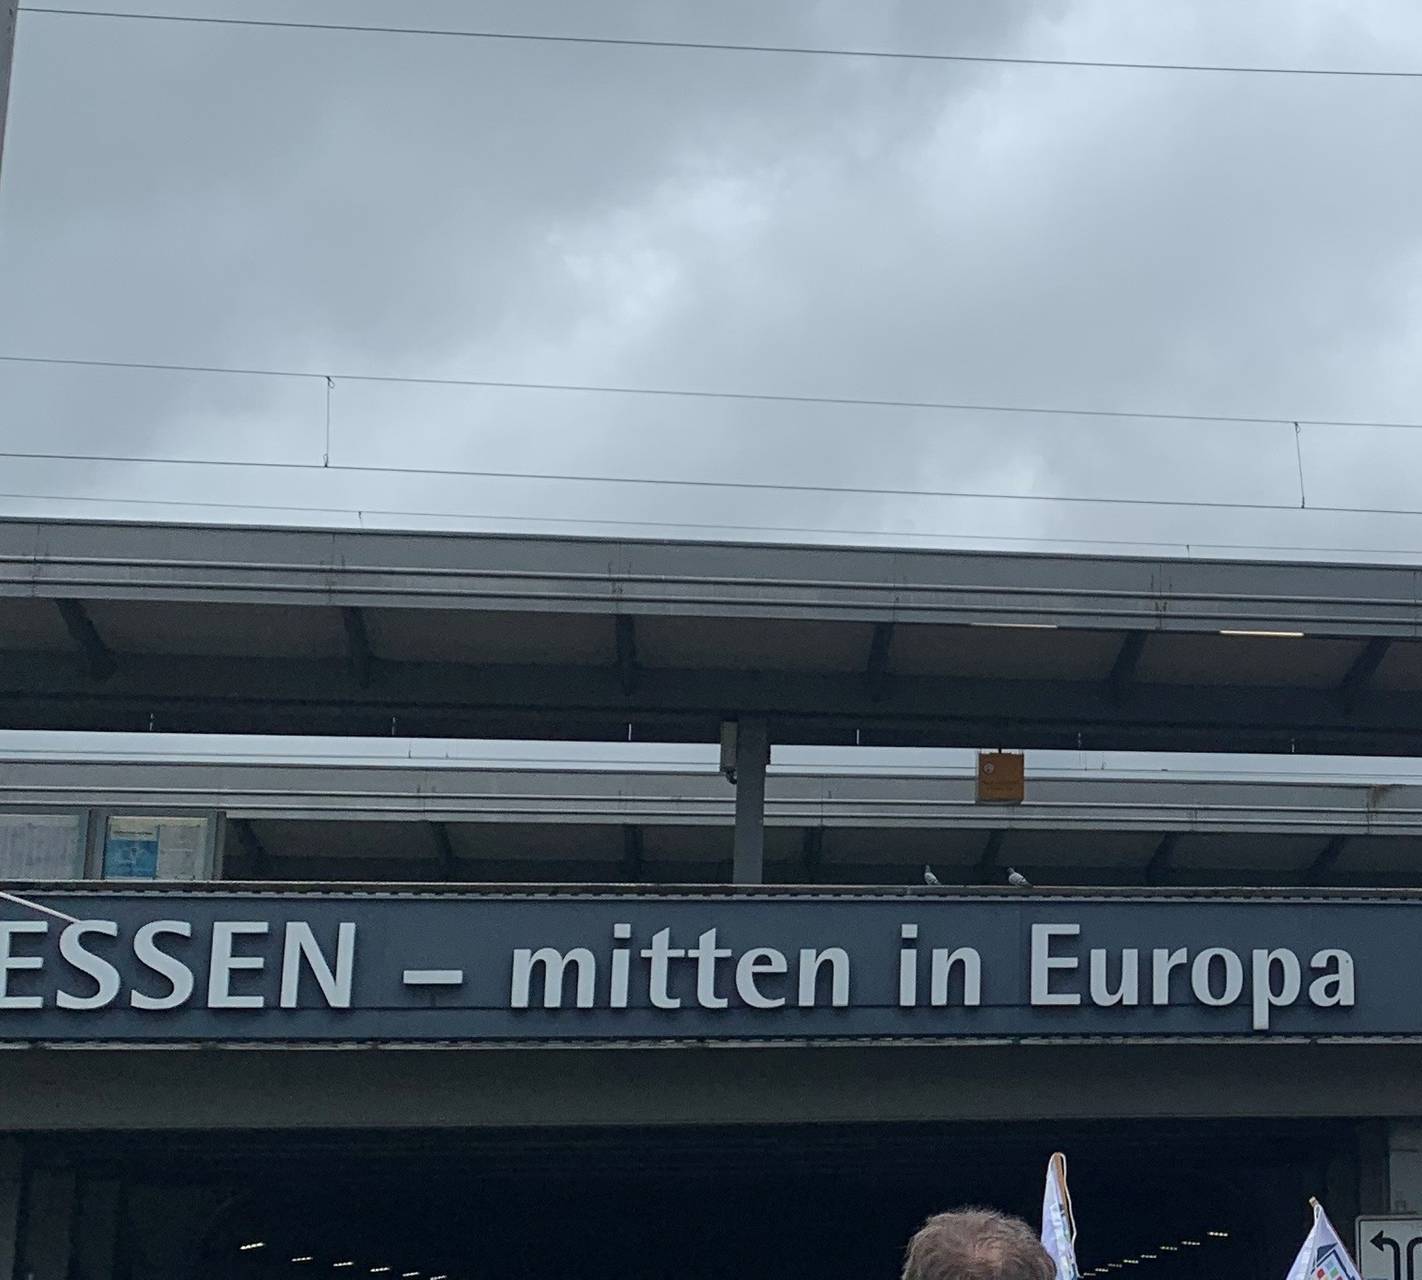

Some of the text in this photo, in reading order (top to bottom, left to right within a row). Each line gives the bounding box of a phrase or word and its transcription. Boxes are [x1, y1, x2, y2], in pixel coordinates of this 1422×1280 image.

[0, 920, 356, 1010] ESSEN
[510, 923, 850, 1009] mitten
[900, 923, 981, 1007] in
[1030, 923, 1356, 1030] Europa
